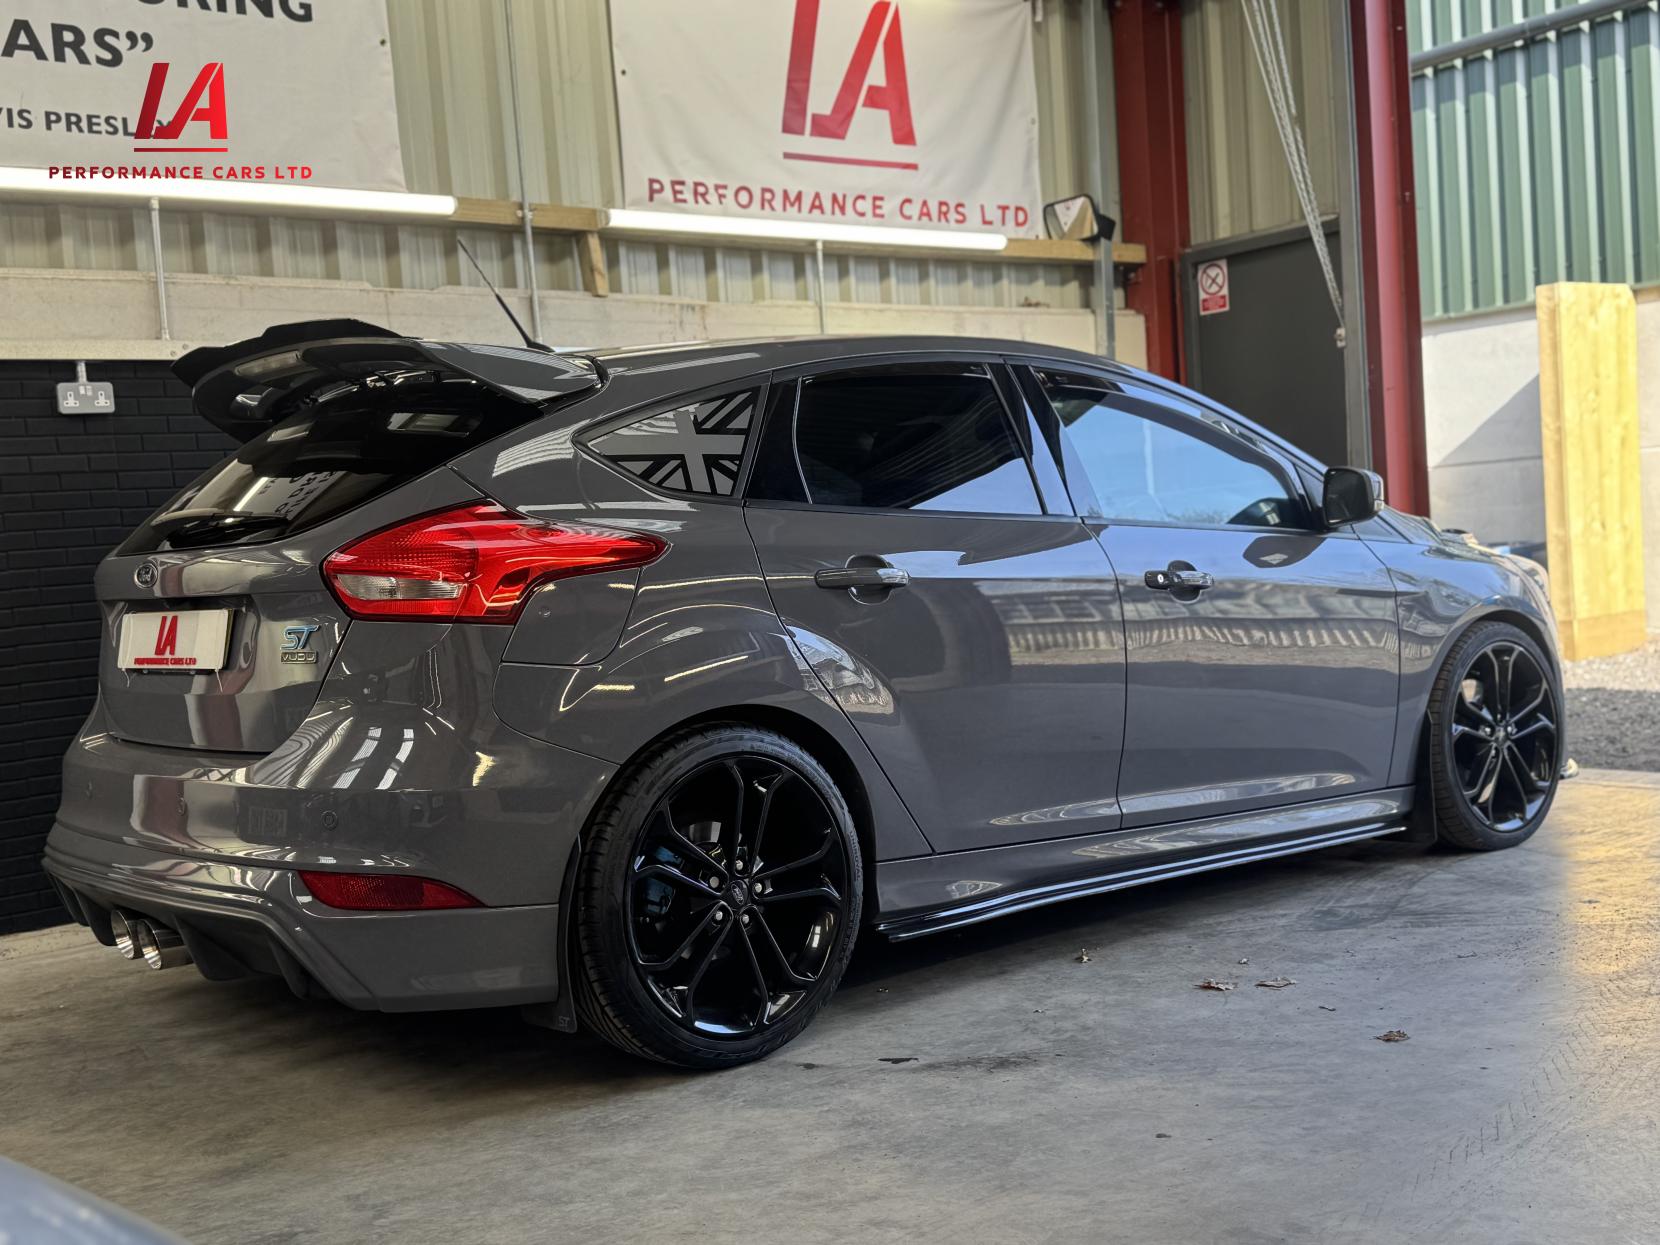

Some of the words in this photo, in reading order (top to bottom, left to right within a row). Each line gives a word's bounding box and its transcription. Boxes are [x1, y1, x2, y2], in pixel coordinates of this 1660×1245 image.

[0, 107, 33, 130] IS
[44, 110, 172, 139] PRESL
[647, 178, 885, 219] PERFORMANCE
[899, 197, 967, 225] CARS
[980, 204, 1029, 228] LTD
[280, 624, 321, 650] ST
